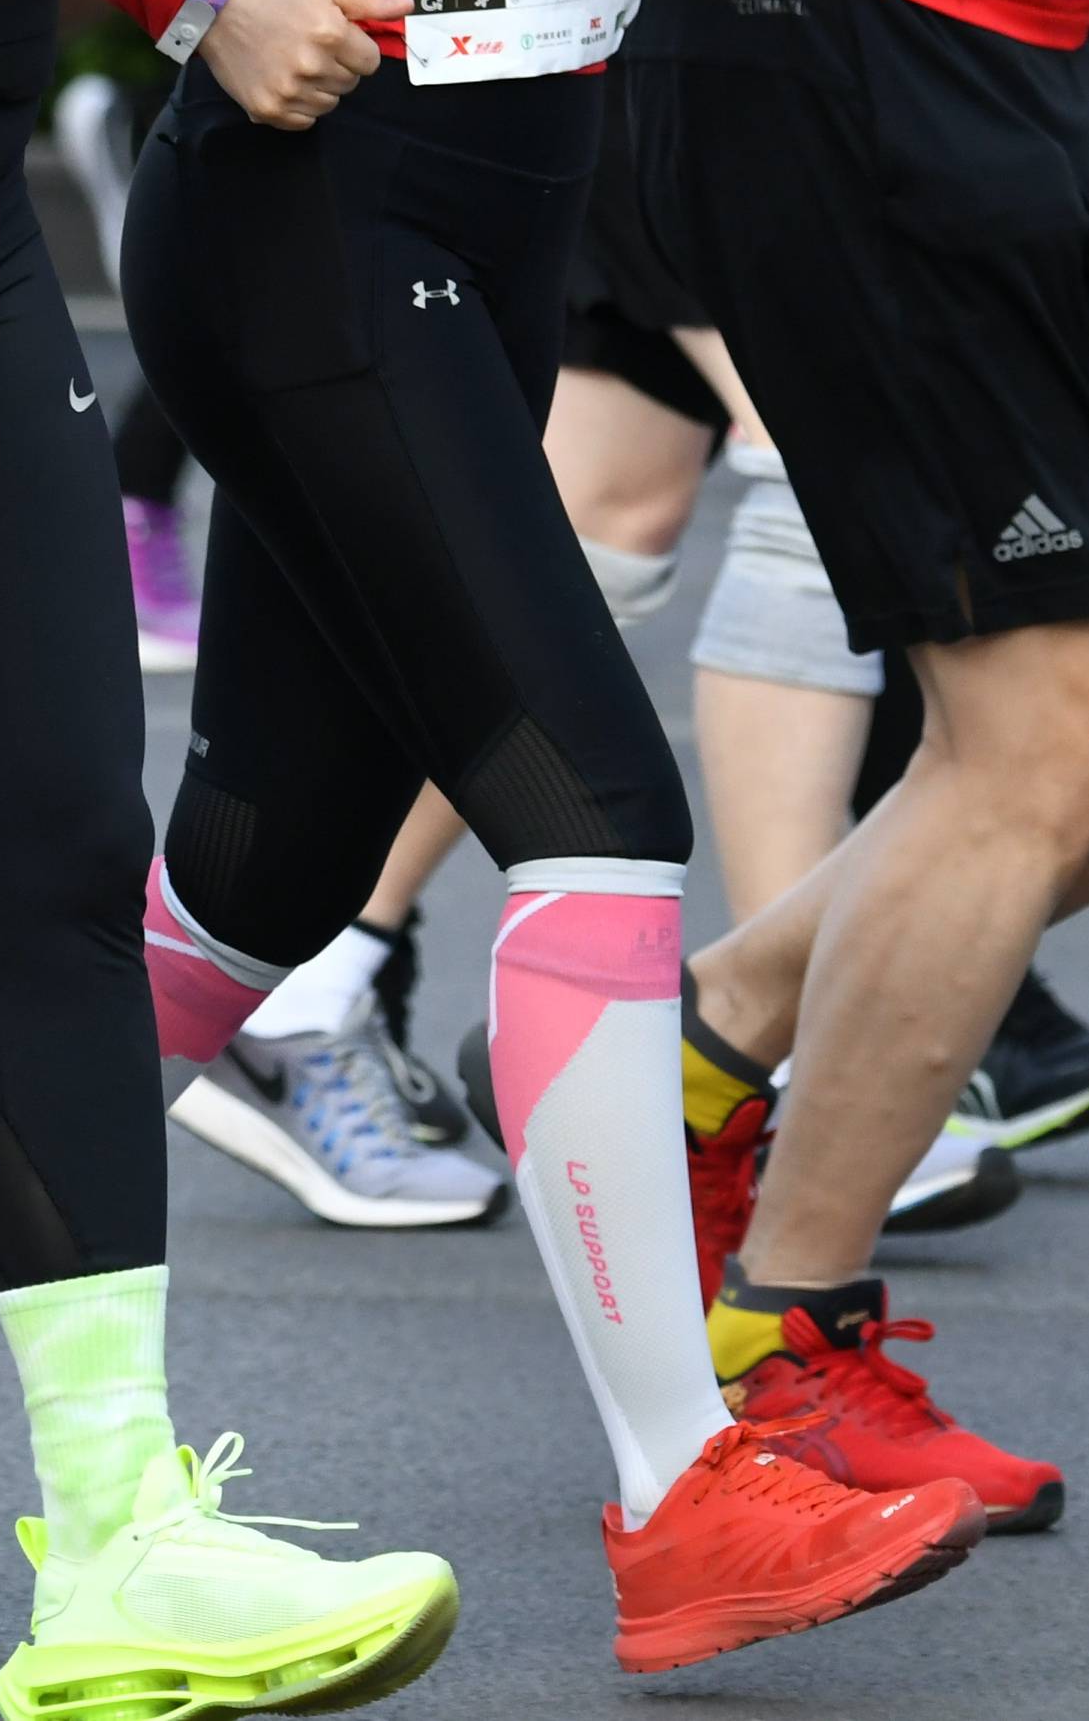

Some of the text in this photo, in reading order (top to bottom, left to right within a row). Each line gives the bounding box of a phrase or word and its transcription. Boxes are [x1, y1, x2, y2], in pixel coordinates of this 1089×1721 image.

[993, 529, 1083, 562] adidas
[566, 1160, 623, 1325] LP SUPPORT
